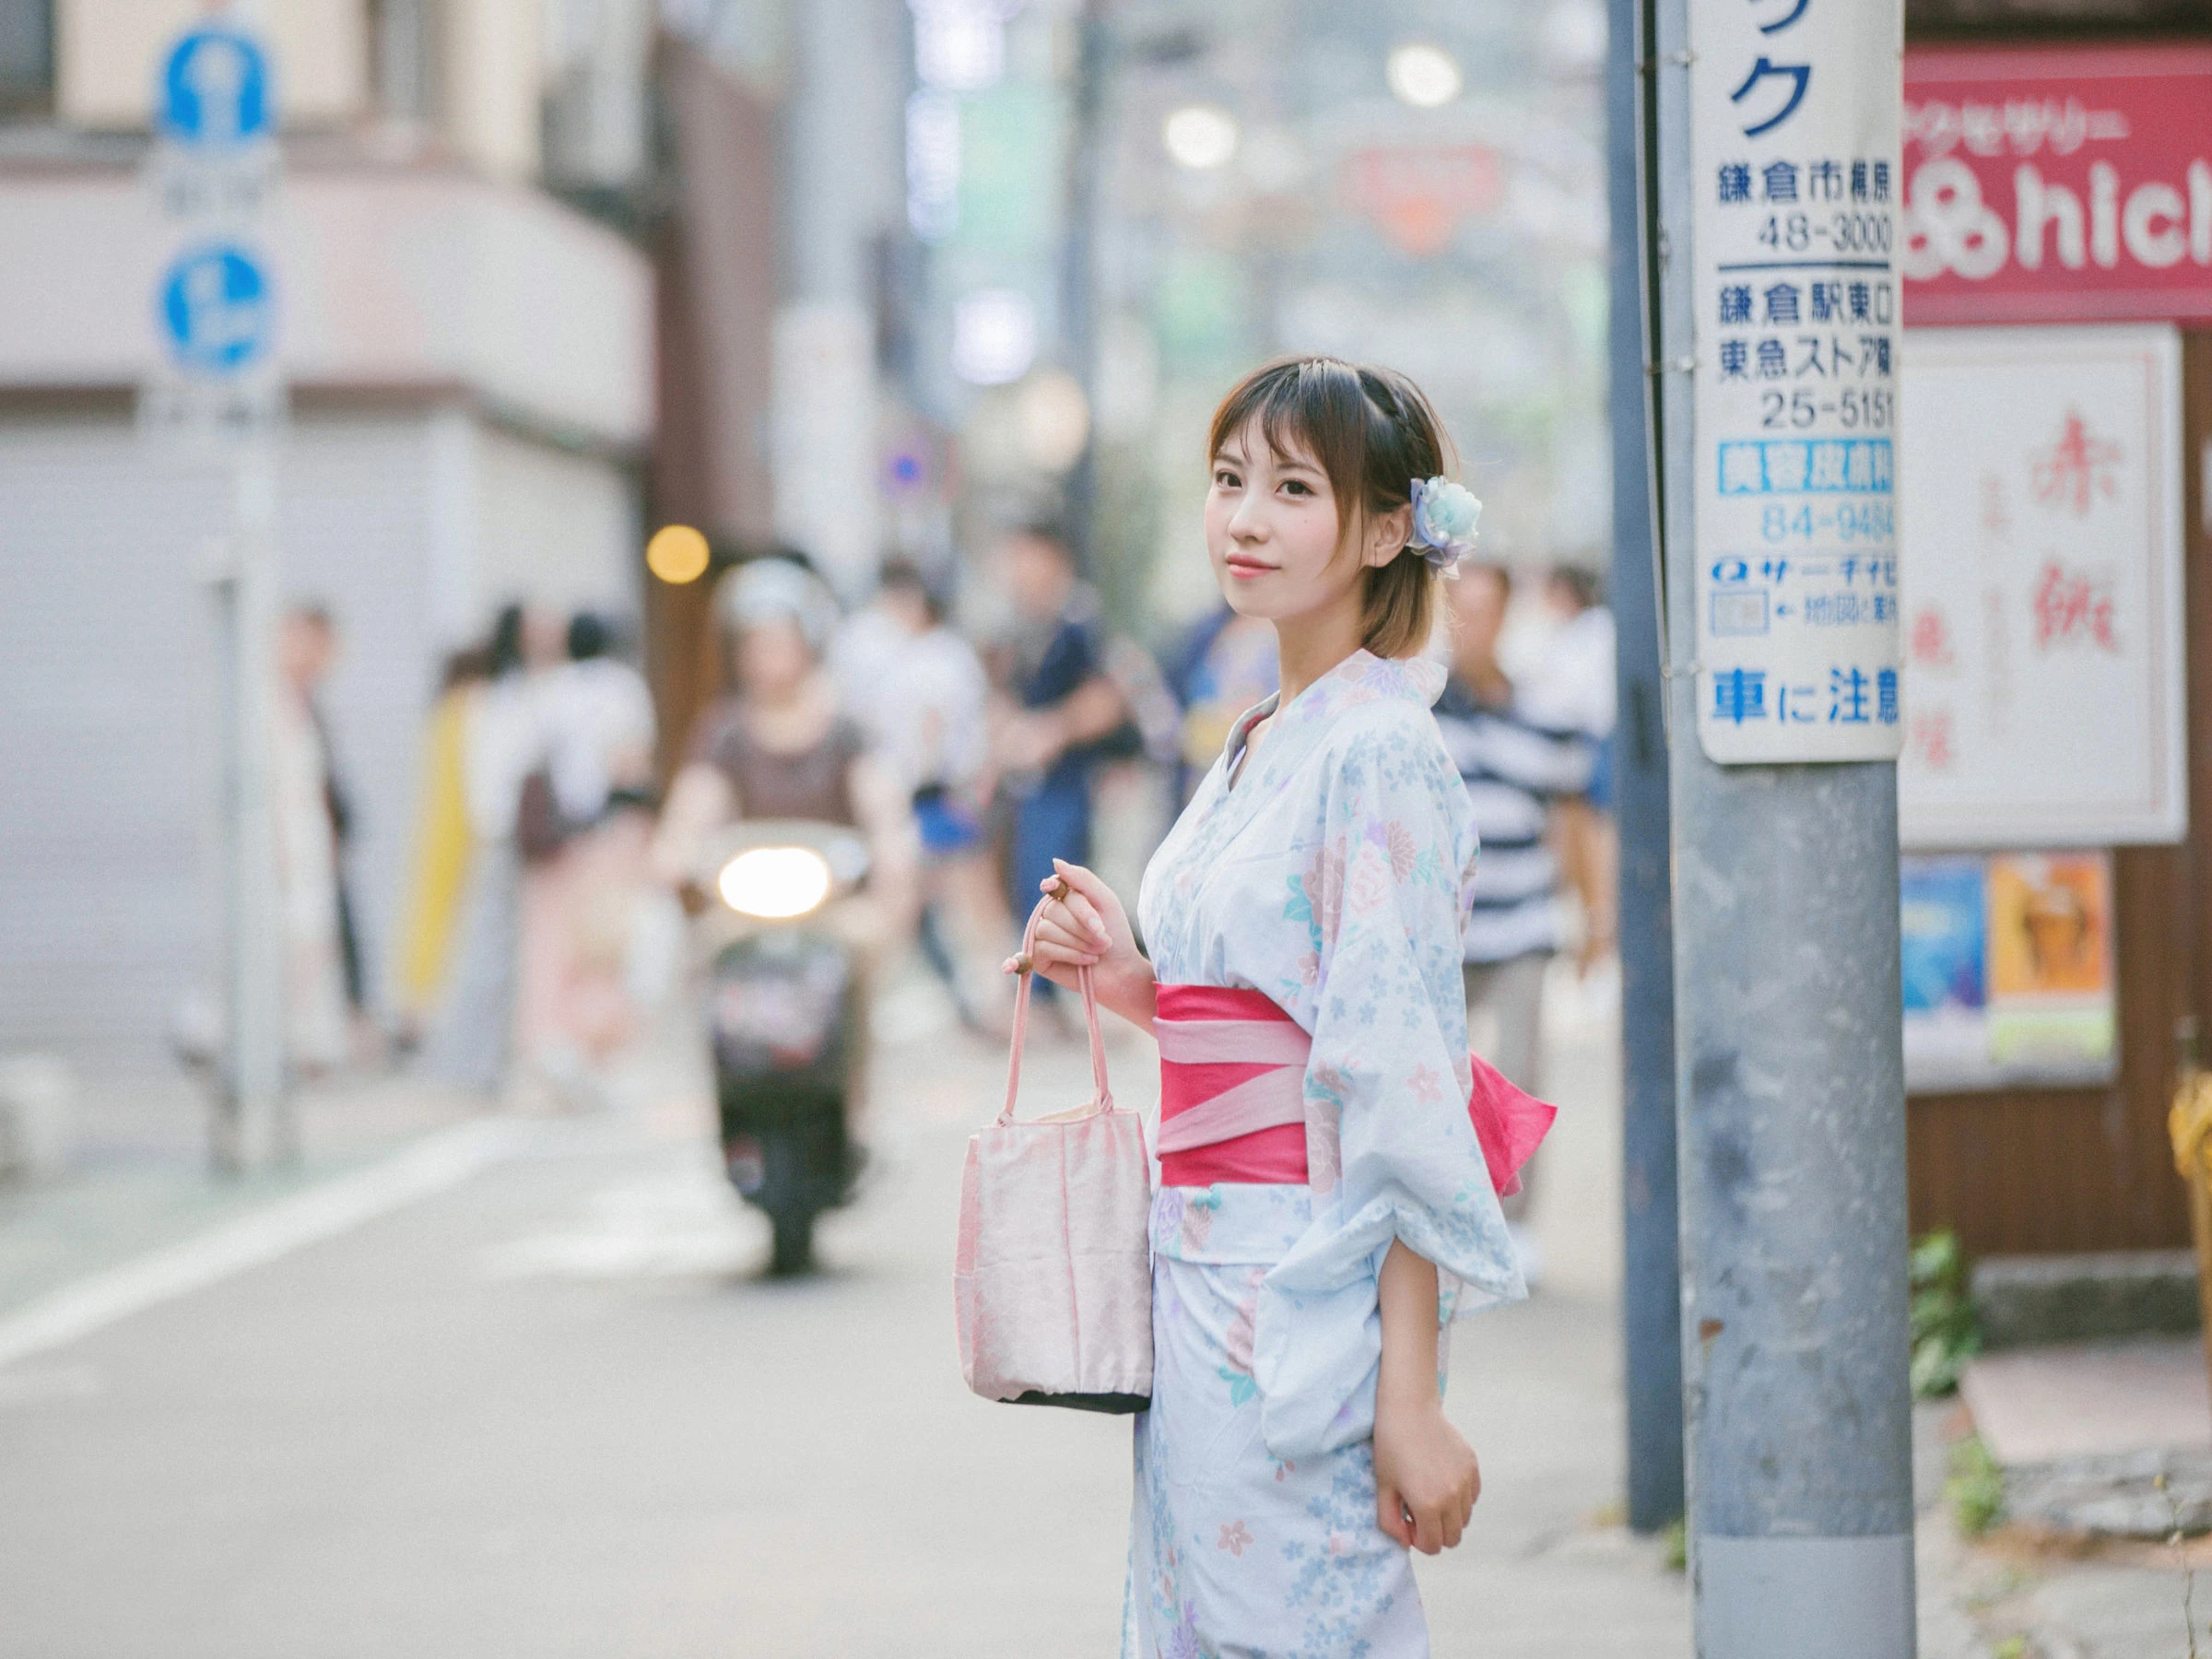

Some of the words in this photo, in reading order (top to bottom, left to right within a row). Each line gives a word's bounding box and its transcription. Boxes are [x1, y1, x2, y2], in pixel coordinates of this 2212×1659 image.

[1759, 212, 1892, 253] 48-3000
[1719, 282, 1892, 325] 鎌倉駅東口
[1761, 389, 1895, 429] 25-5151
[1712, 667, 1899, 724] 車に注意
